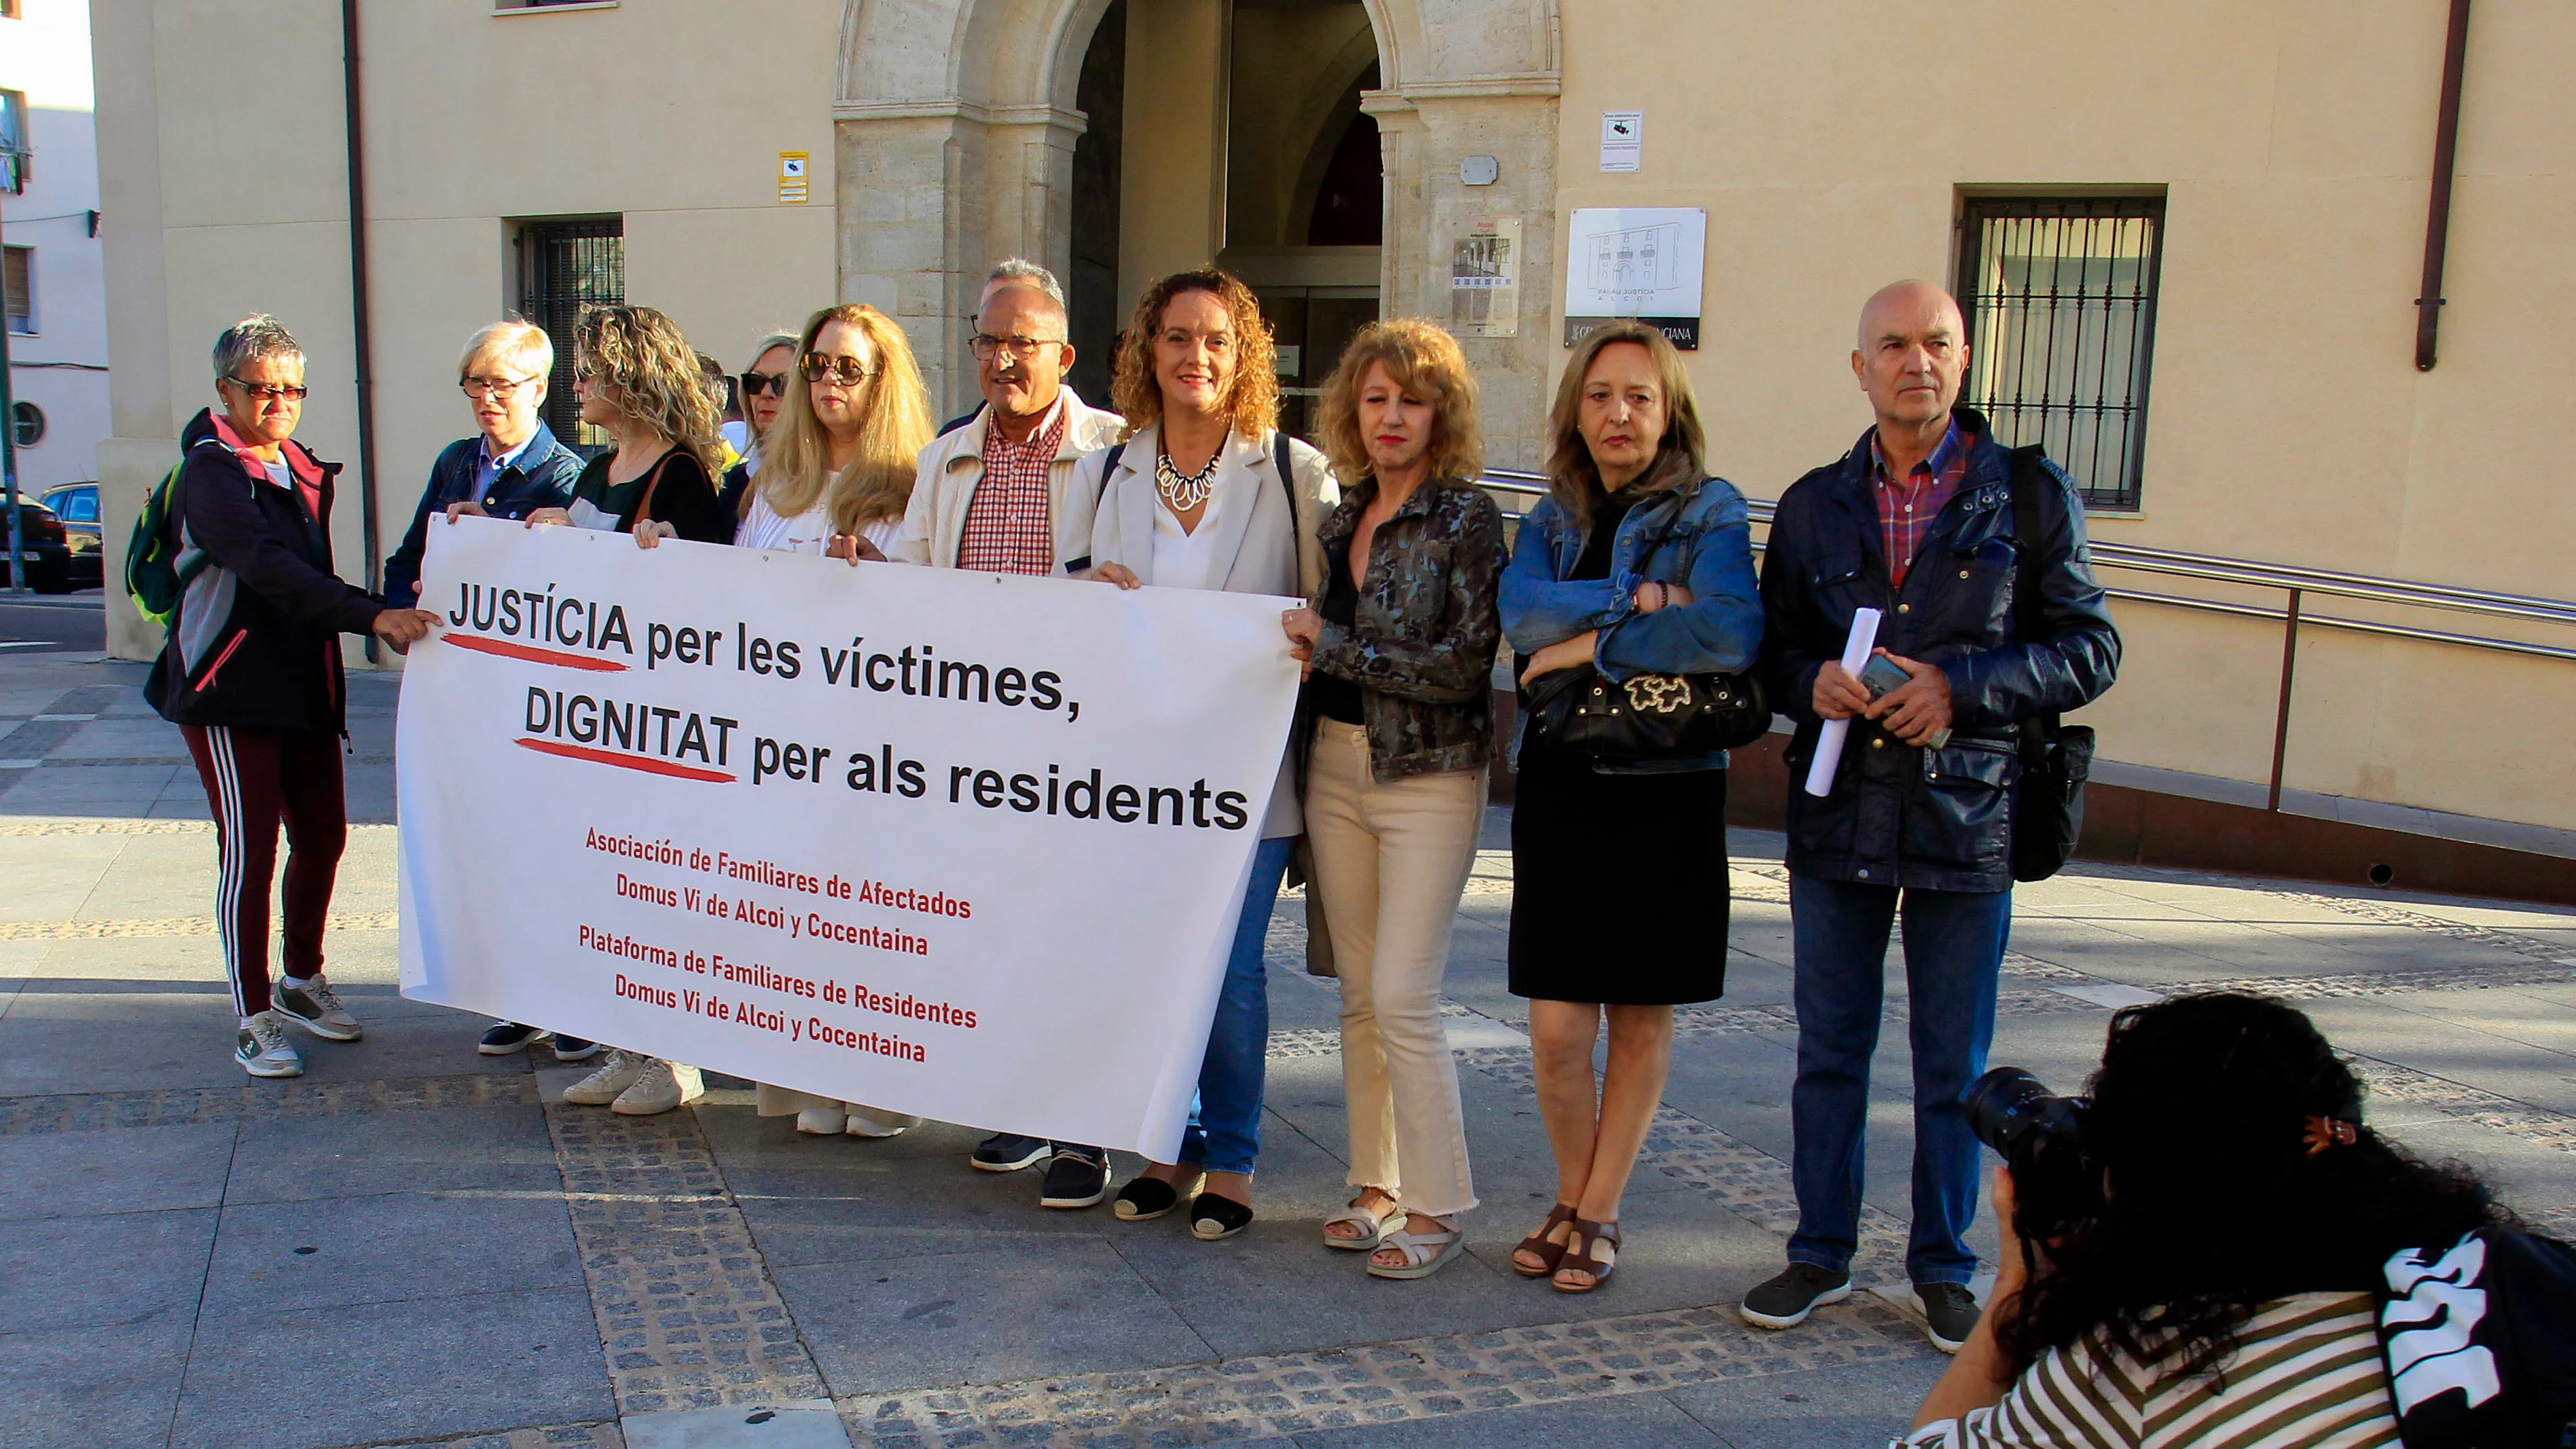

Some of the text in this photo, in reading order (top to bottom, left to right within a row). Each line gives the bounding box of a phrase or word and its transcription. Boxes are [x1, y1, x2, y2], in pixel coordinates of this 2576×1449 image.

[449, 583, 1079, 723] JUSTÍCIA per les víctimes,
[526, 686, 1248, 830] DIGNITAT per als residents
[586, 828, 971, 919] Asociación de Familiares de Afectados
[617, 873, 928, 955] Domus Vi de Alcoi y Cocentaina
[580, 925, 977, 1029] Plataforma de Familiares de Residentes
[616, 974, 926, 1063] Domus Vi de Alcoi y Cocentaina
